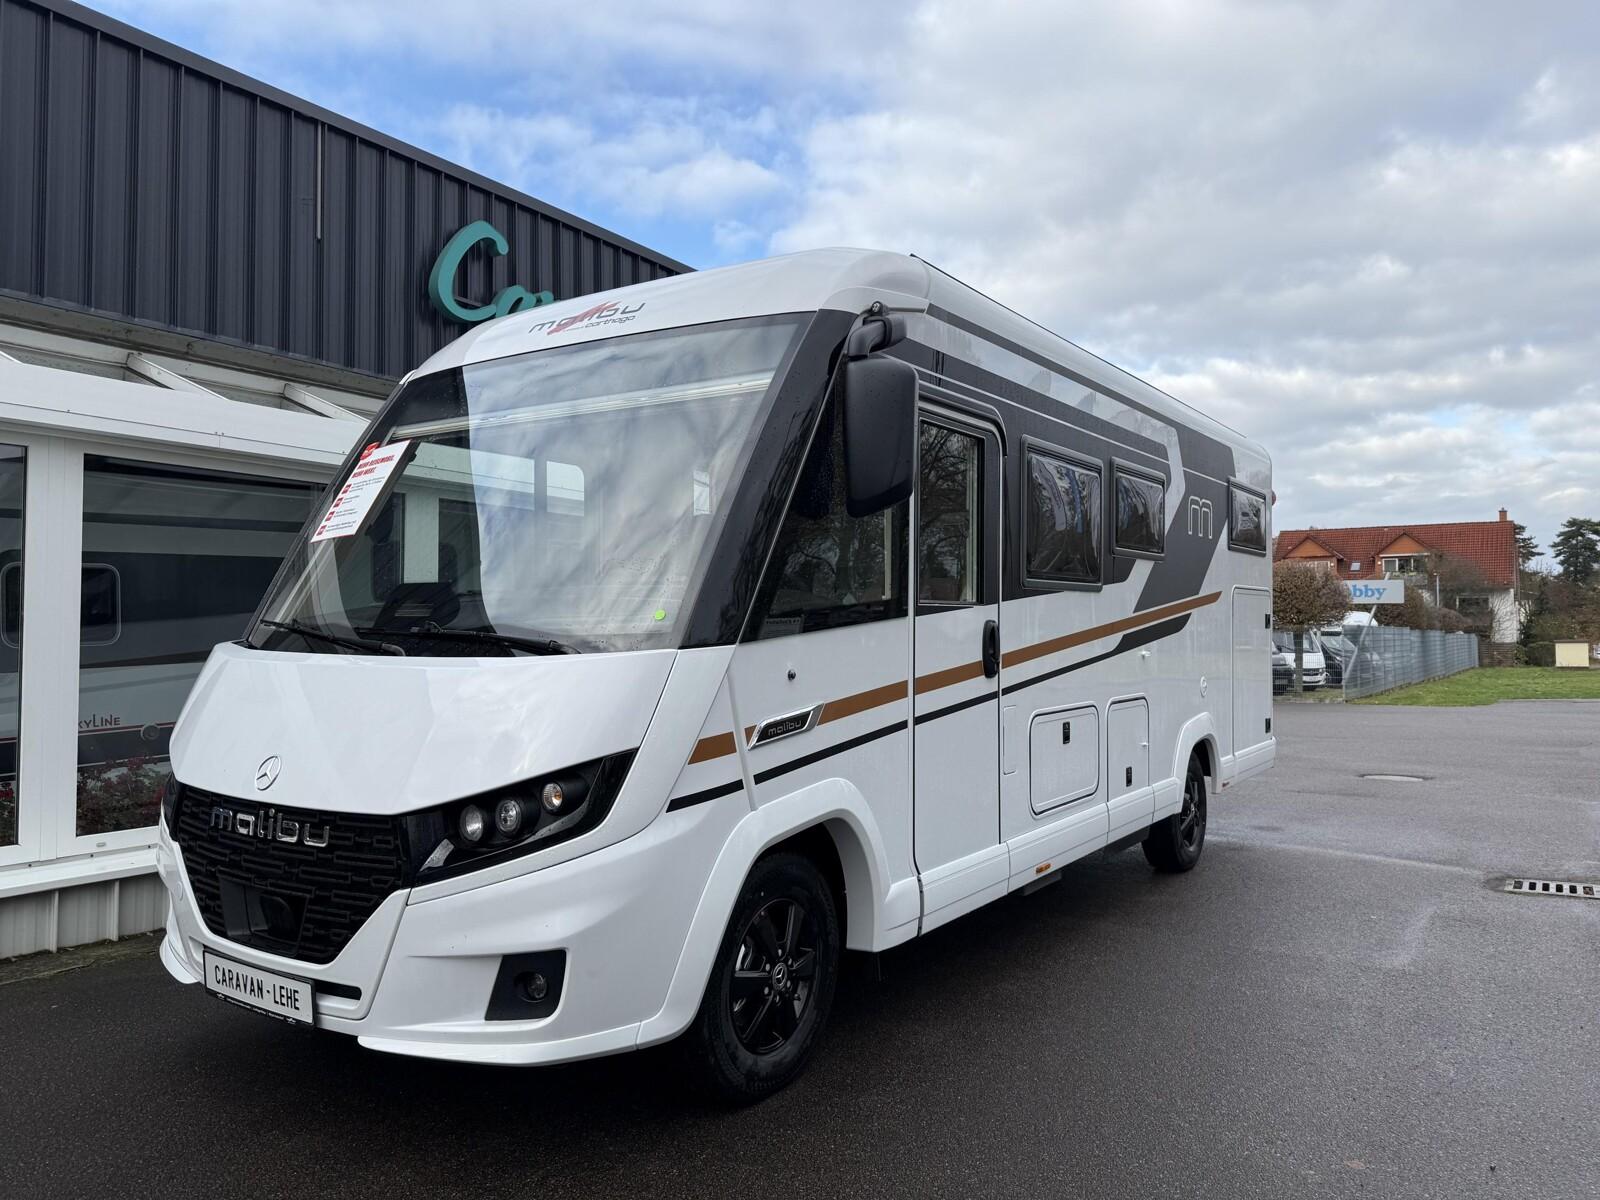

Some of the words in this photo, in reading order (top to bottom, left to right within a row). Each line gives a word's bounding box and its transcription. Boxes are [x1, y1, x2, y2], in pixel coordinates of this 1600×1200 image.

[528, 302, 646, 335] maibu
[1347, 584, 1387, 600] bby
[768, 721, 802, 736] malibu
[211, 806, 330, 847] malibu
